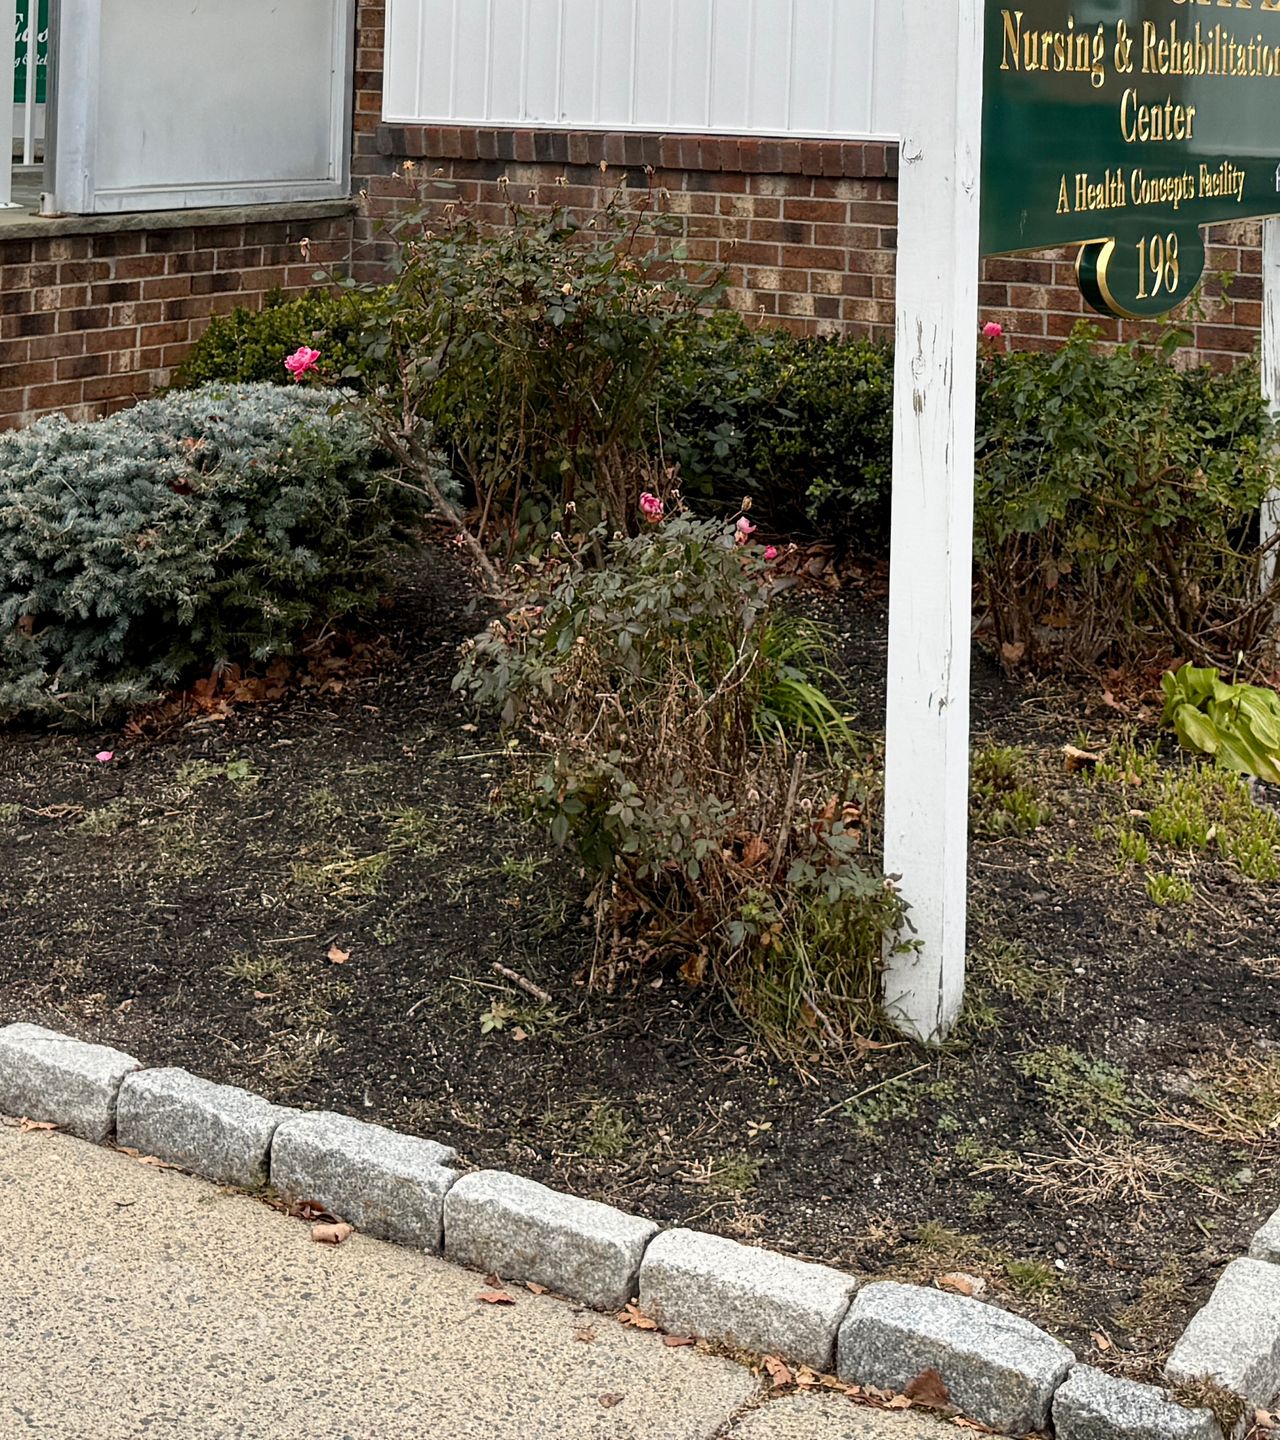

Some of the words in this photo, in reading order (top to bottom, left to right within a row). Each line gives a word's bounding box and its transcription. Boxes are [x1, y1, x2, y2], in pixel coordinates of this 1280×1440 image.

[1000, 9, 1106, 88] Nursing
[1114, 18, 1134, 74] &
[1120, 87, 1196, 143] Center
[1056, 174, 1070, 214] A
[1074, 168, 1126, 212] Health
[1130, 168, 1195, 209] Concepts
[1199, 160, 1246, 202] Facility
[1135, 231, 1179, 299] 198
